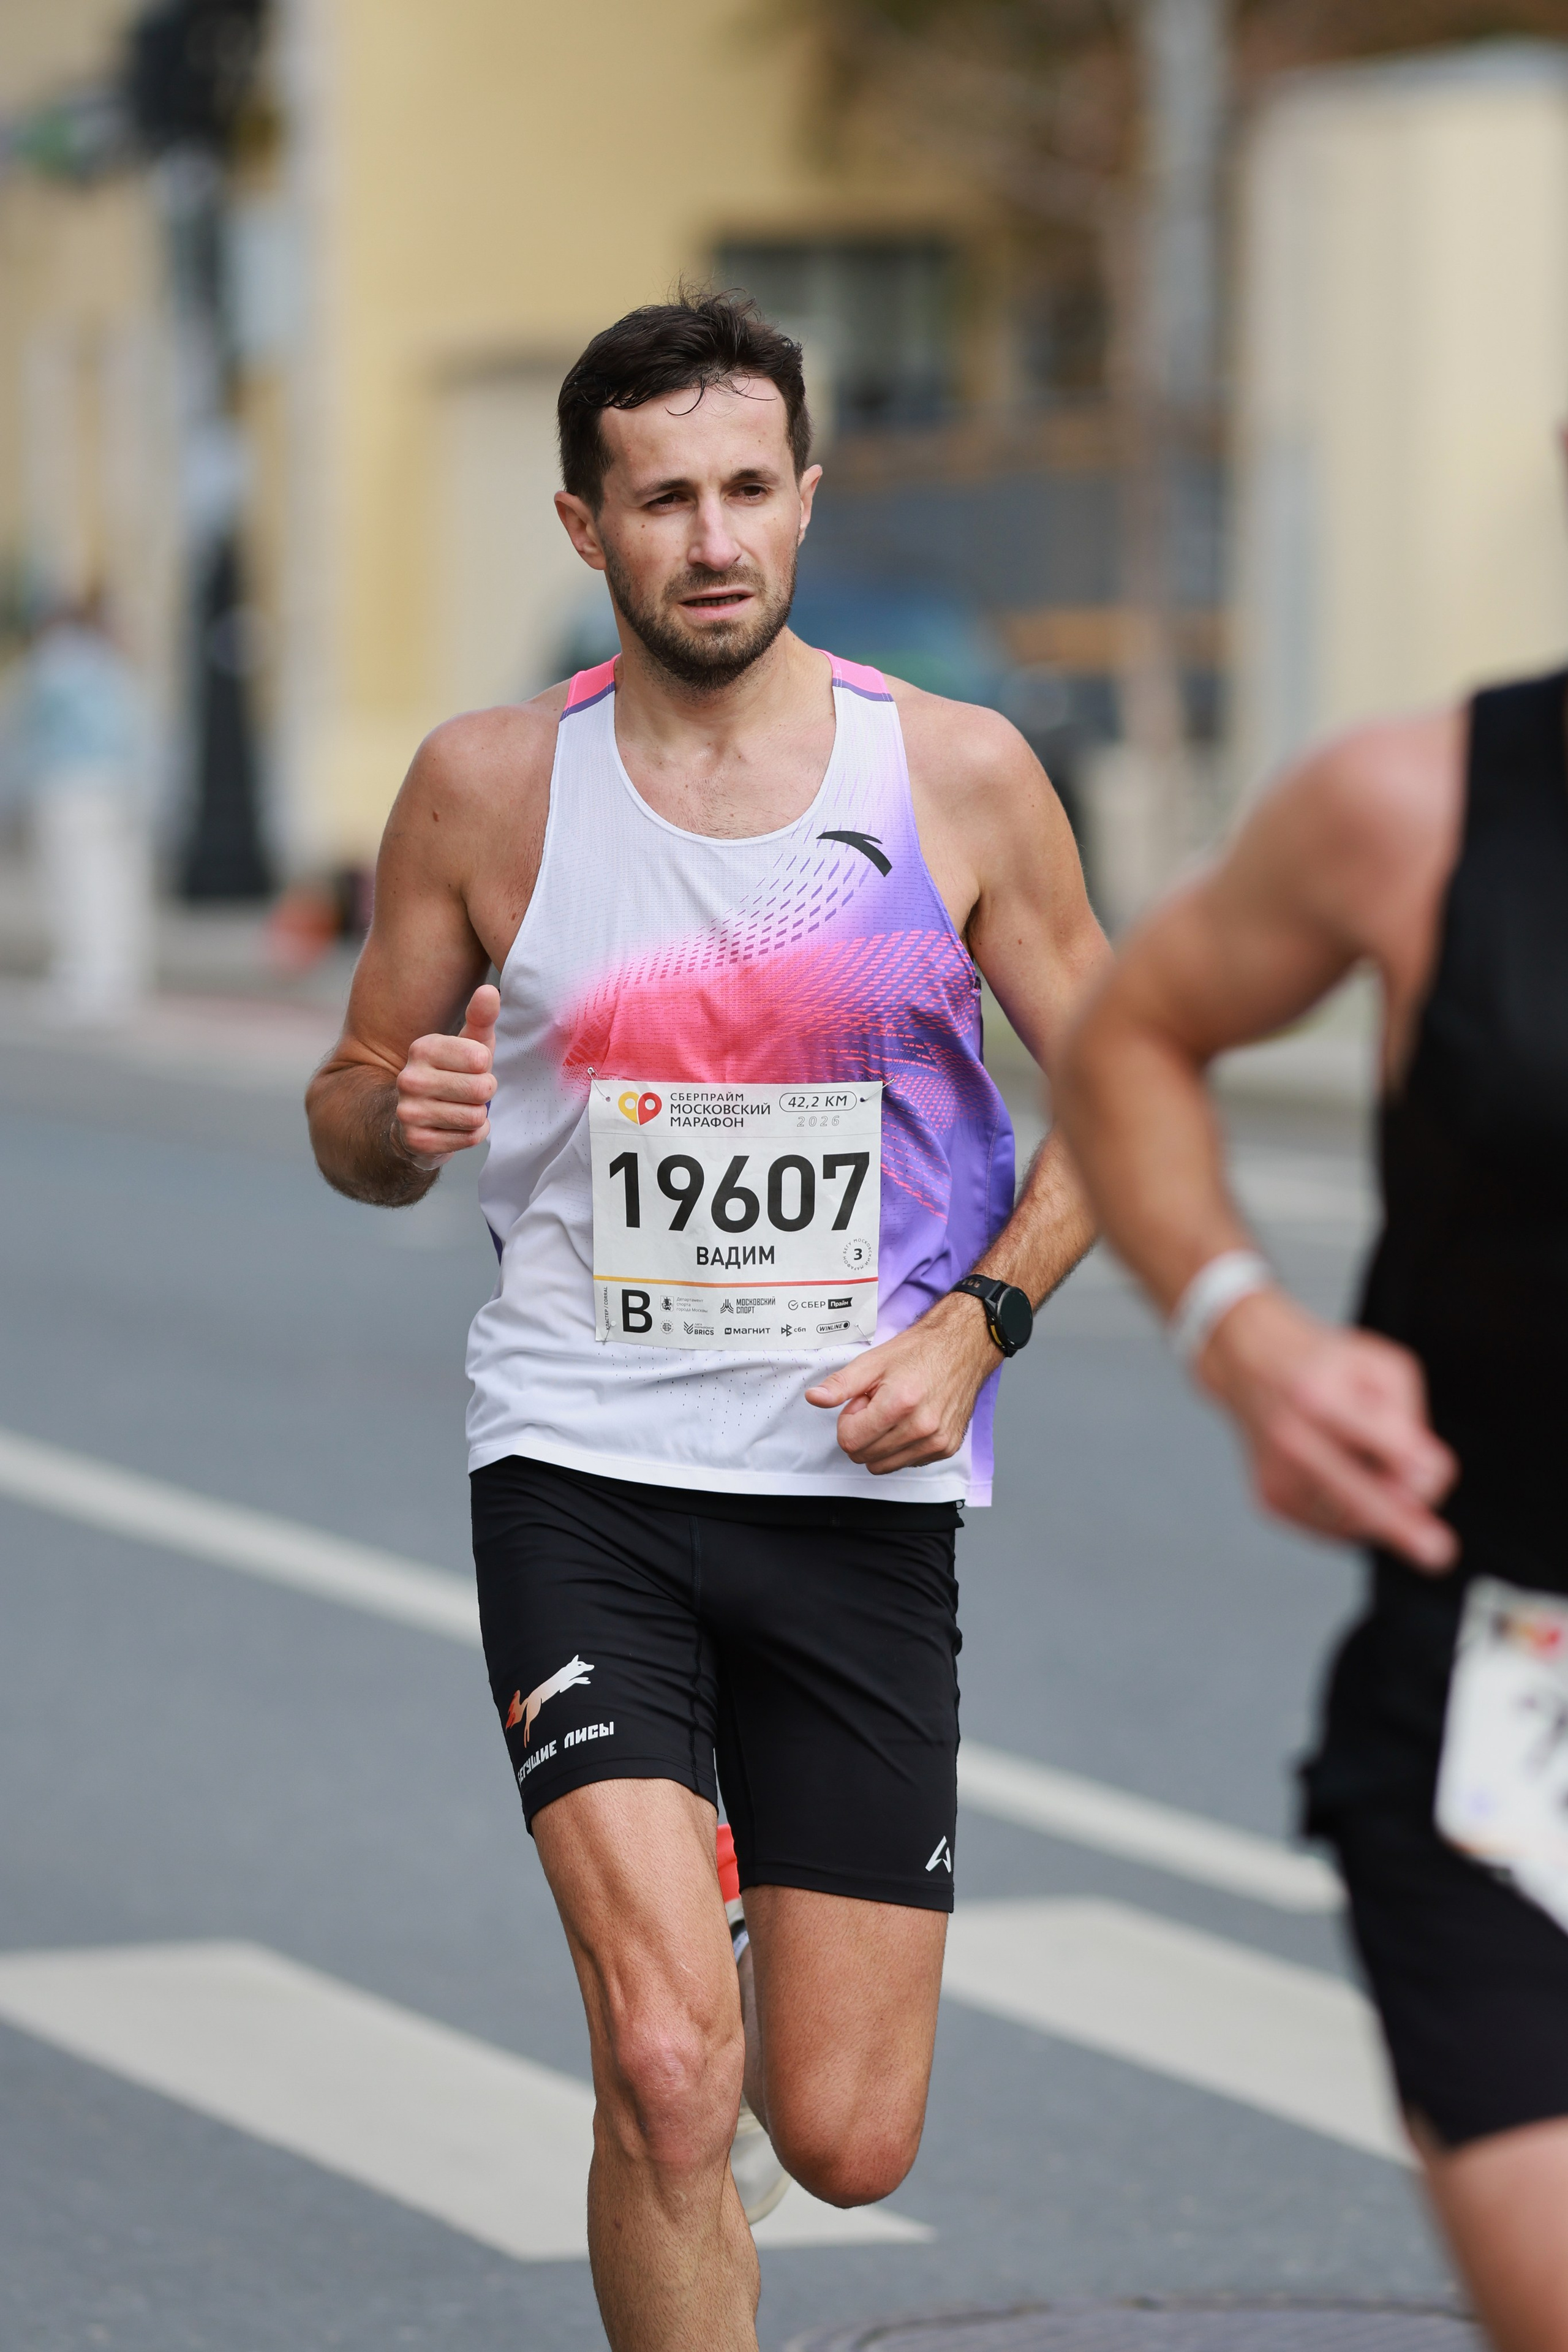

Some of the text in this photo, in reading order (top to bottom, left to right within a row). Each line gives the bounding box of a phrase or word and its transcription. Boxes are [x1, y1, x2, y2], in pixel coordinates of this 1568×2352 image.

[670, 1091, 744, 1101] СБЕРПРАЙМ
[670, 1102, 771, 1115] МОСКОВСКИЙ
[788, 1096, 820, 1109] 42,2
[670, 1117, 744, 1128] МАРАФОН
[797, 1115, 840, 1127] 2026
[609, 1152, 870, 1233] 19607
[696, 1245, 775, 1269] ВАДИМ
[853, 1248, 862, 1261] 3
[736, 1296, 776, 1306] МОСКОВСКИЙ
[830, 1299, 849, 1308] Прайм
[819, 1323, 843, 1332] WINLINE
[564, 1721, 614, 1749] ЛИСЫ
